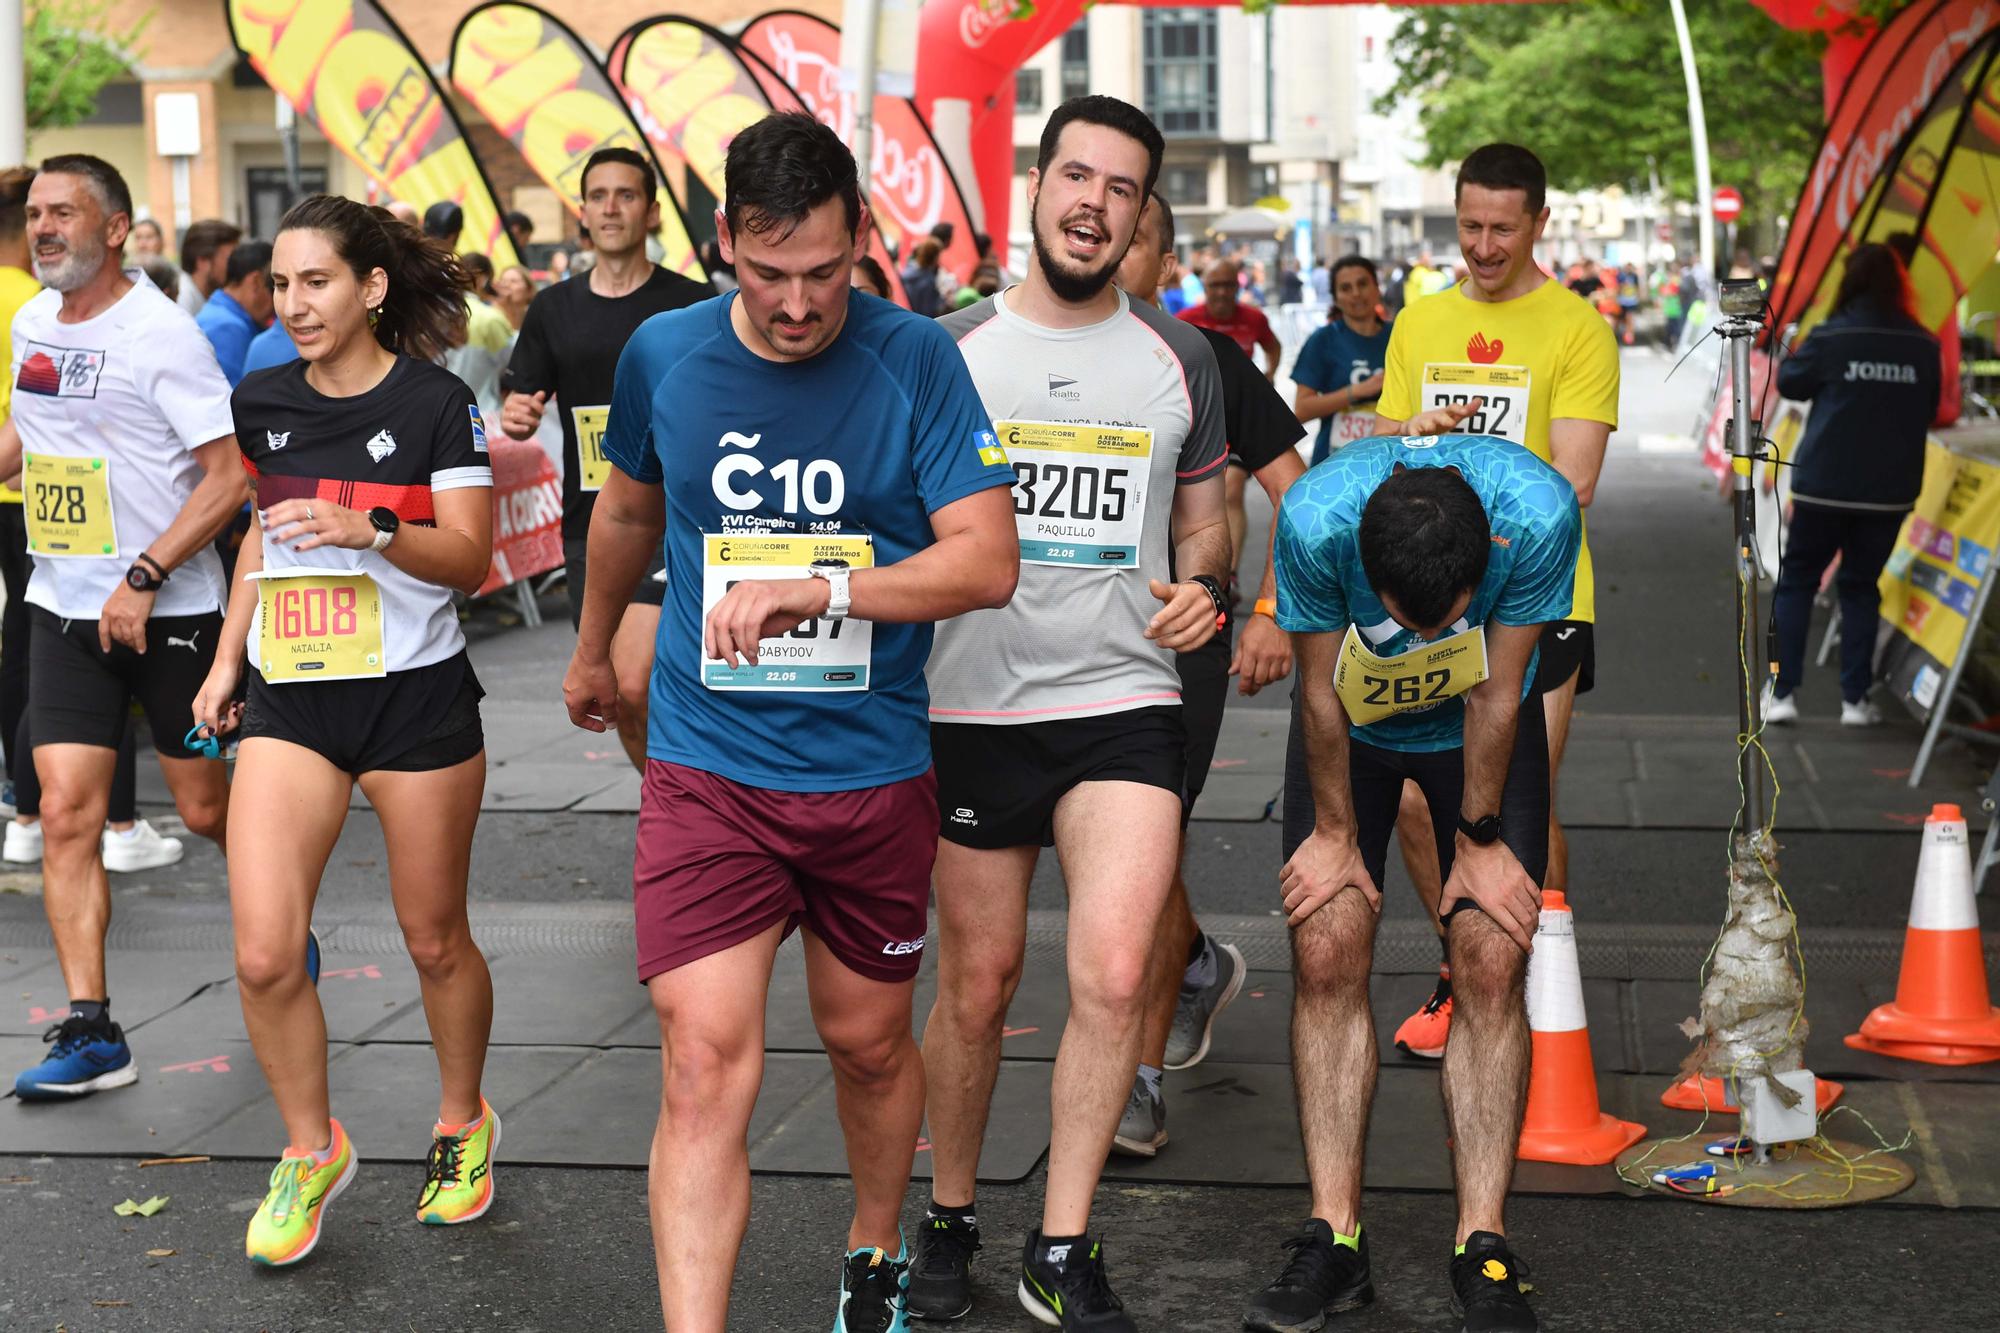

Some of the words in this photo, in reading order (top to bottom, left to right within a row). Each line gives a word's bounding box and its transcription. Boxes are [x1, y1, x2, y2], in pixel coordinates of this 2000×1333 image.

[1012, 462, 1128, 521] 3205
[36, 482, 86, 523] 328
[721, 515, 743, 526] XVI
[745, 515, 796, 529] Carreira
[810, 521, 841, 531] 24.04
[1037, 524, 1095, 537] PAQUILLO
[1047, 548, 1075, 558] 22.05
[275, 587, 356, 640] 1608
[291, 643, 332, 654] NATALIA
[758, 647, 814, 658] DABYDOV
[766, 672, 796, 681] 22.05
[1363, 669, 1450, 704] 262
[950, 815, 978, 826] Kalenji
